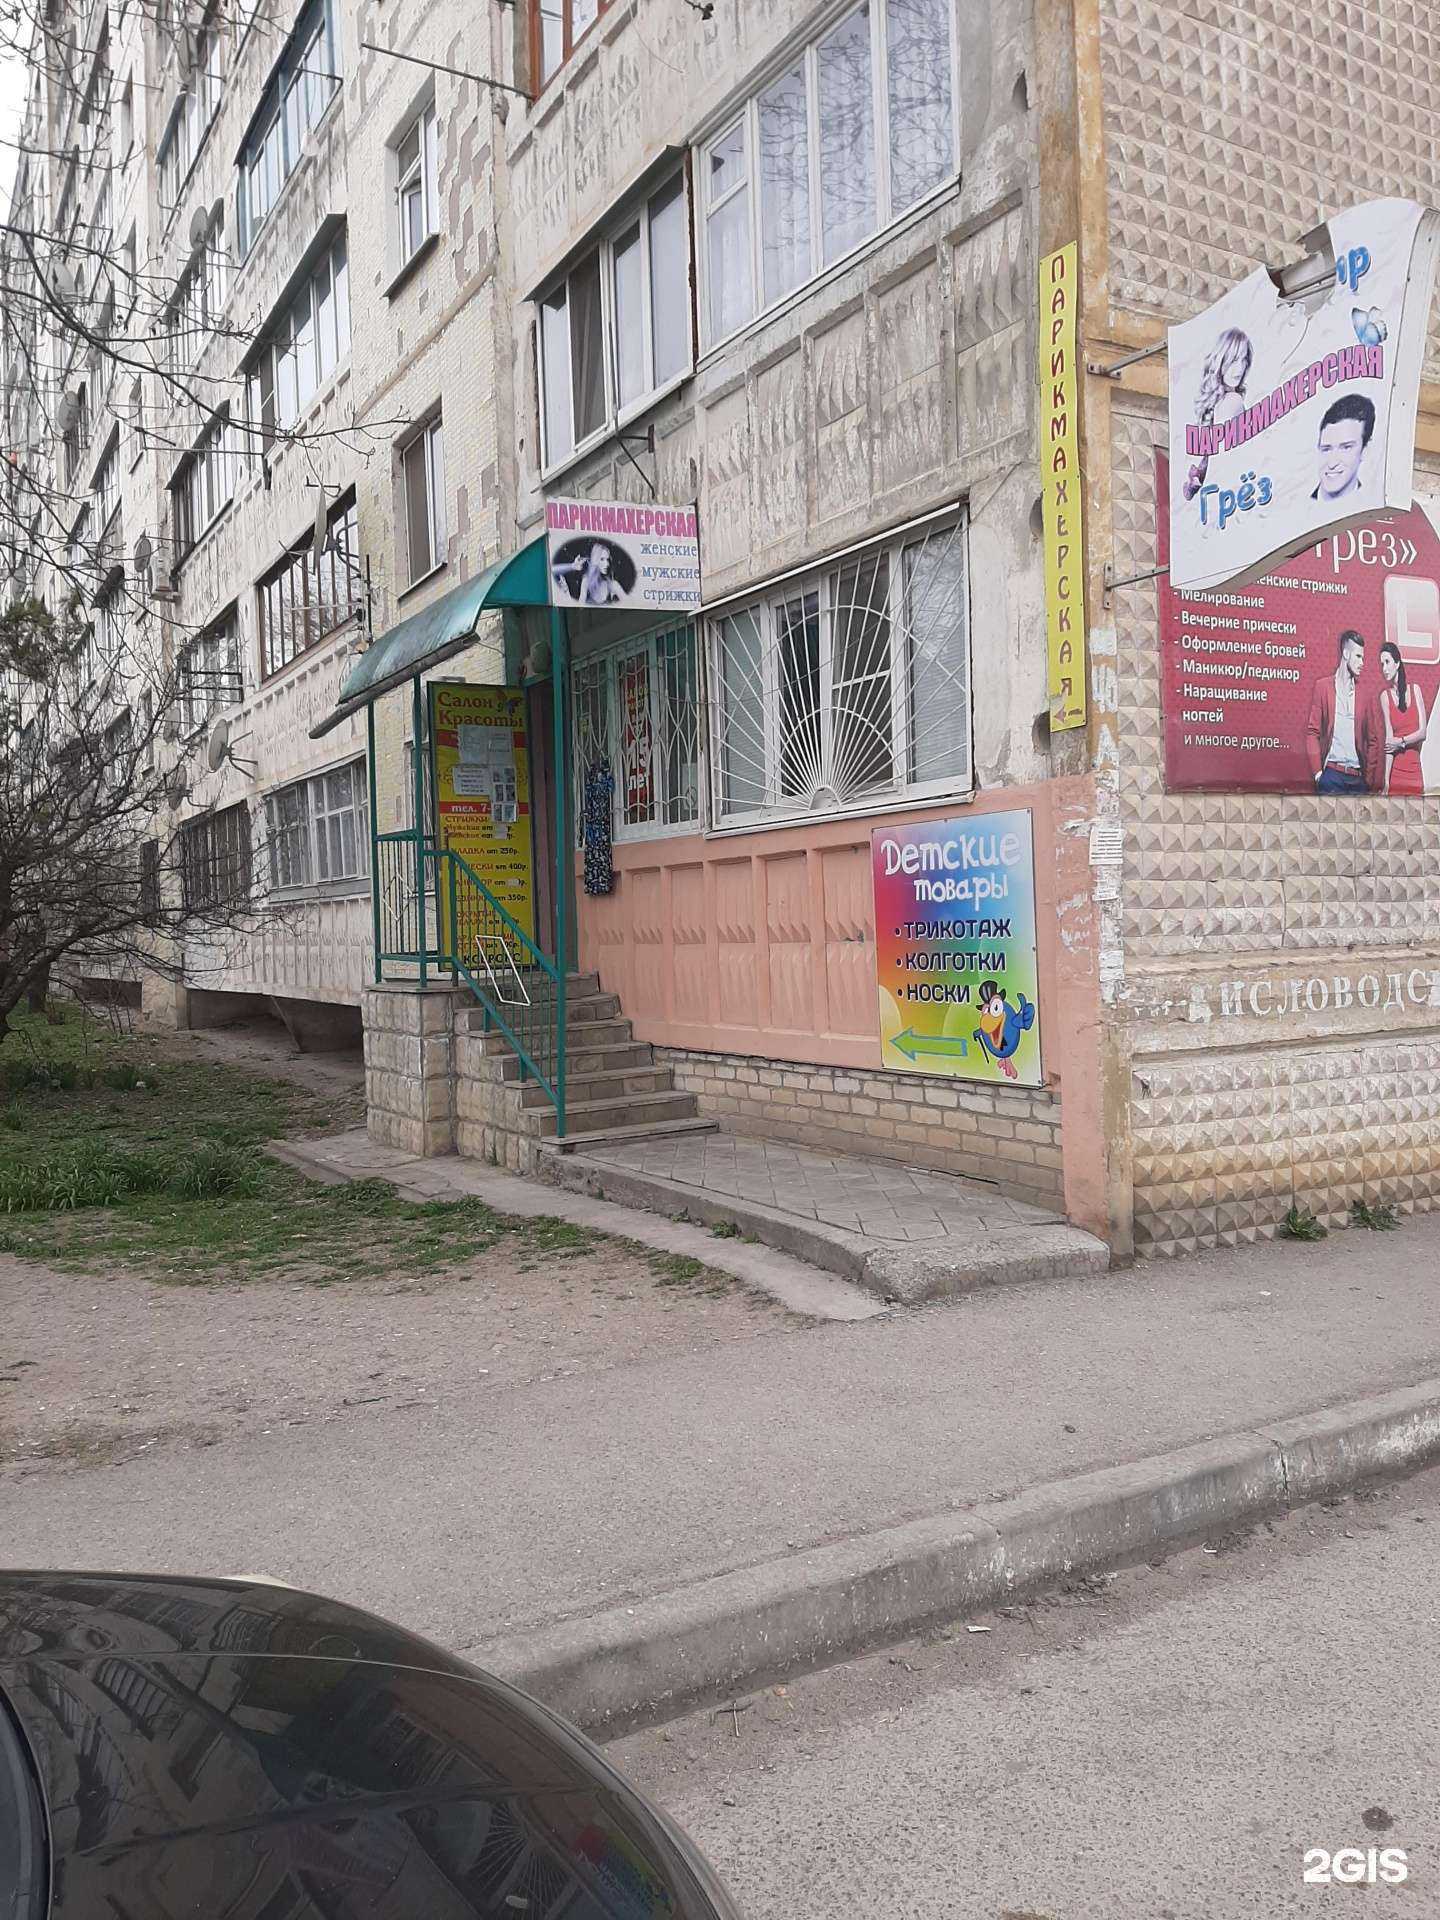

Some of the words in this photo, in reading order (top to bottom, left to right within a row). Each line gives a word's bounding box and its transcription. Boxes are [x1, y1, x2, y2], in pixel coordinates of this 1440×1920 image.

[1186, 345, 1384, 456] ПАРИКМАХЕРСКАЯ
[1049, 254, 1073, 697] ПАРИКМАХЕРСКАЯ
[1199, 470, 1273, 530] Грёз
[546, 502, 697, 537] ПАРИКМАХЕРСКАЯ
[640, 543, 697, 556] женские
[641, 566, 700, 581] мужские
[1256, 575, 1299, 589] енские
[1301, 579, 1348, 594] стрижки
[643, 589, 701, 604] стрижки
[1181, 590, 1265, 608] Мелирование
[1181, 611, 1240, 630] Вечерние
[1243, 619, 1297, 635] прически
[1182, 635, 1262, 655] Оформление
[1265, 640, 1306, 658] бровей
[1183, 658, 1300, 682] Маникюр/педикюр
[437, 691, 493, 709] Салон
[1183, 683, 1268, 702] Наращивание
[438, 709, 524, 729] Красоты
[1183, 708, 1224, 723] ногтей
[1184, 735, 1192, 745] и
[1195, 735, 1238, 748] многое
[880, 831, 1023, 876] Детские
[914, 873, 1009, 911] товары
[904, 918, 1012, 939] ТРИКОТАЖ
[905, 951, 1006, 972] КОЛГОТКИ
[907, 984, 970, 1003] НОСКИ
